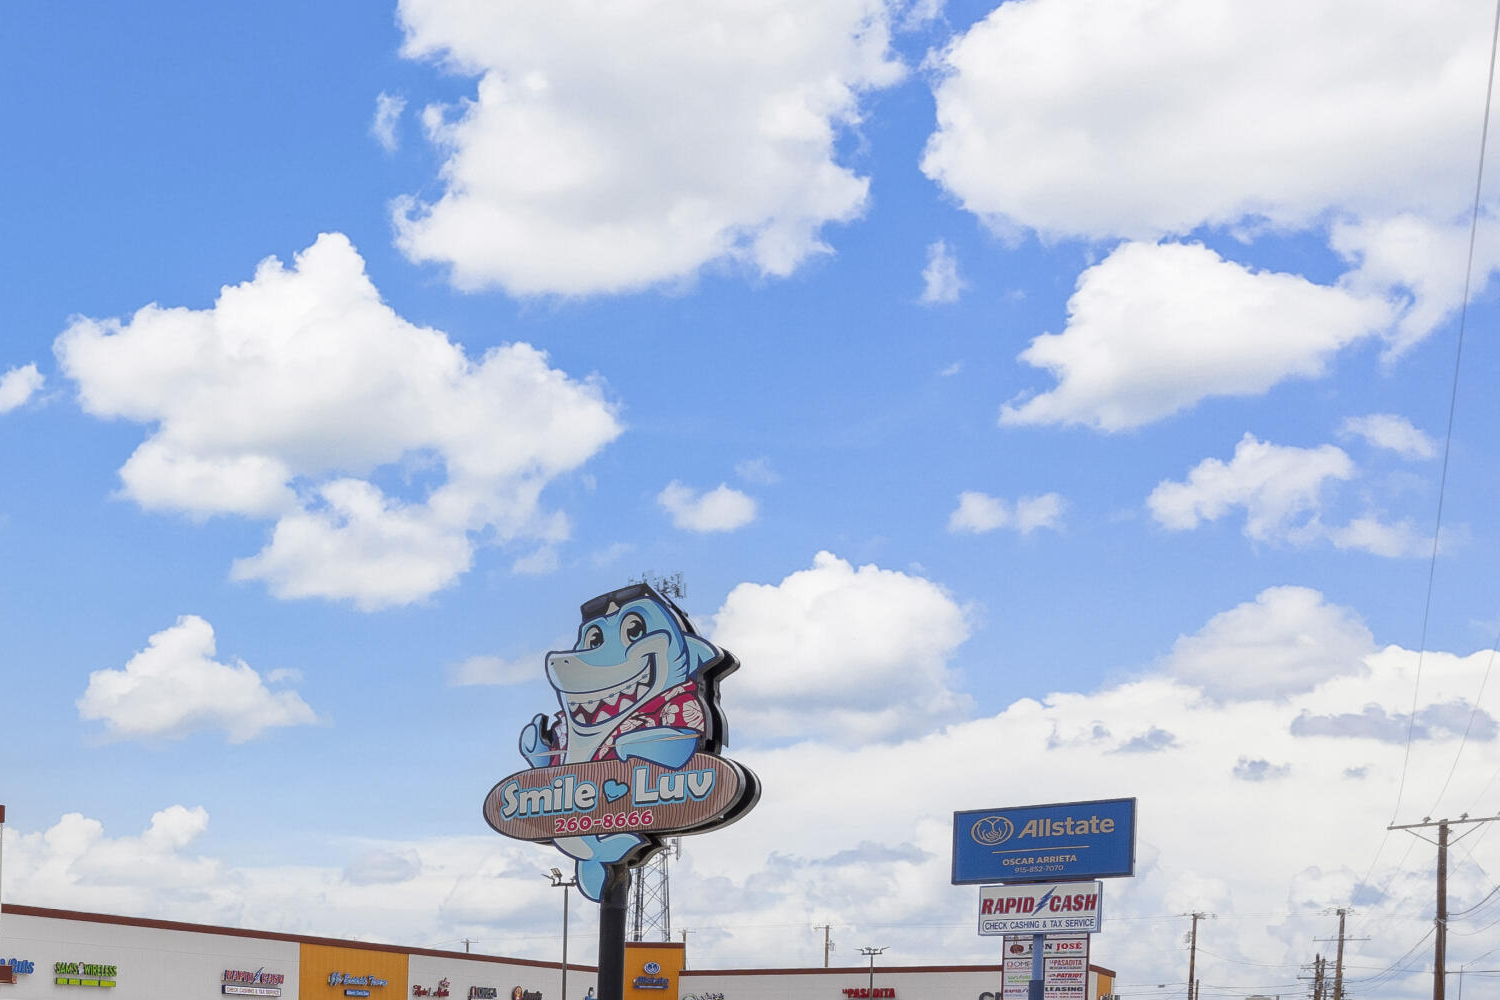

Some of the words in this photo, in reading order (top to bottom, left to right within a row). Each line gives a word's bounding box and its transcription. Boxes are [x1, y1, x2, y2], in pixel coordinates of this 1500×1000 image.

[502, 775, 598, 819] Smile
[633, 766, 716, 806] Luv
[555, 811, 653, 833] 260-8666
[1018, 815, 1115, 839] Allstate
[1002, 858, 1035, 866] OSCAR
[1036, 855, 1077, 864] ARRIETA
[981, 896, 1035, 915] RAPID
[1049, 894, 1098, 912] CASH
[985, 921, 1007, 930] CHECK
[1010, 920, 1040, 930] CASHING
[1042, 920, 1047, 928] &
[1050, 919, 1063, 928] TAX
[1065, 918, 1094, 928] SERVICE
[83, 964, 117, 976] WIRELESS
